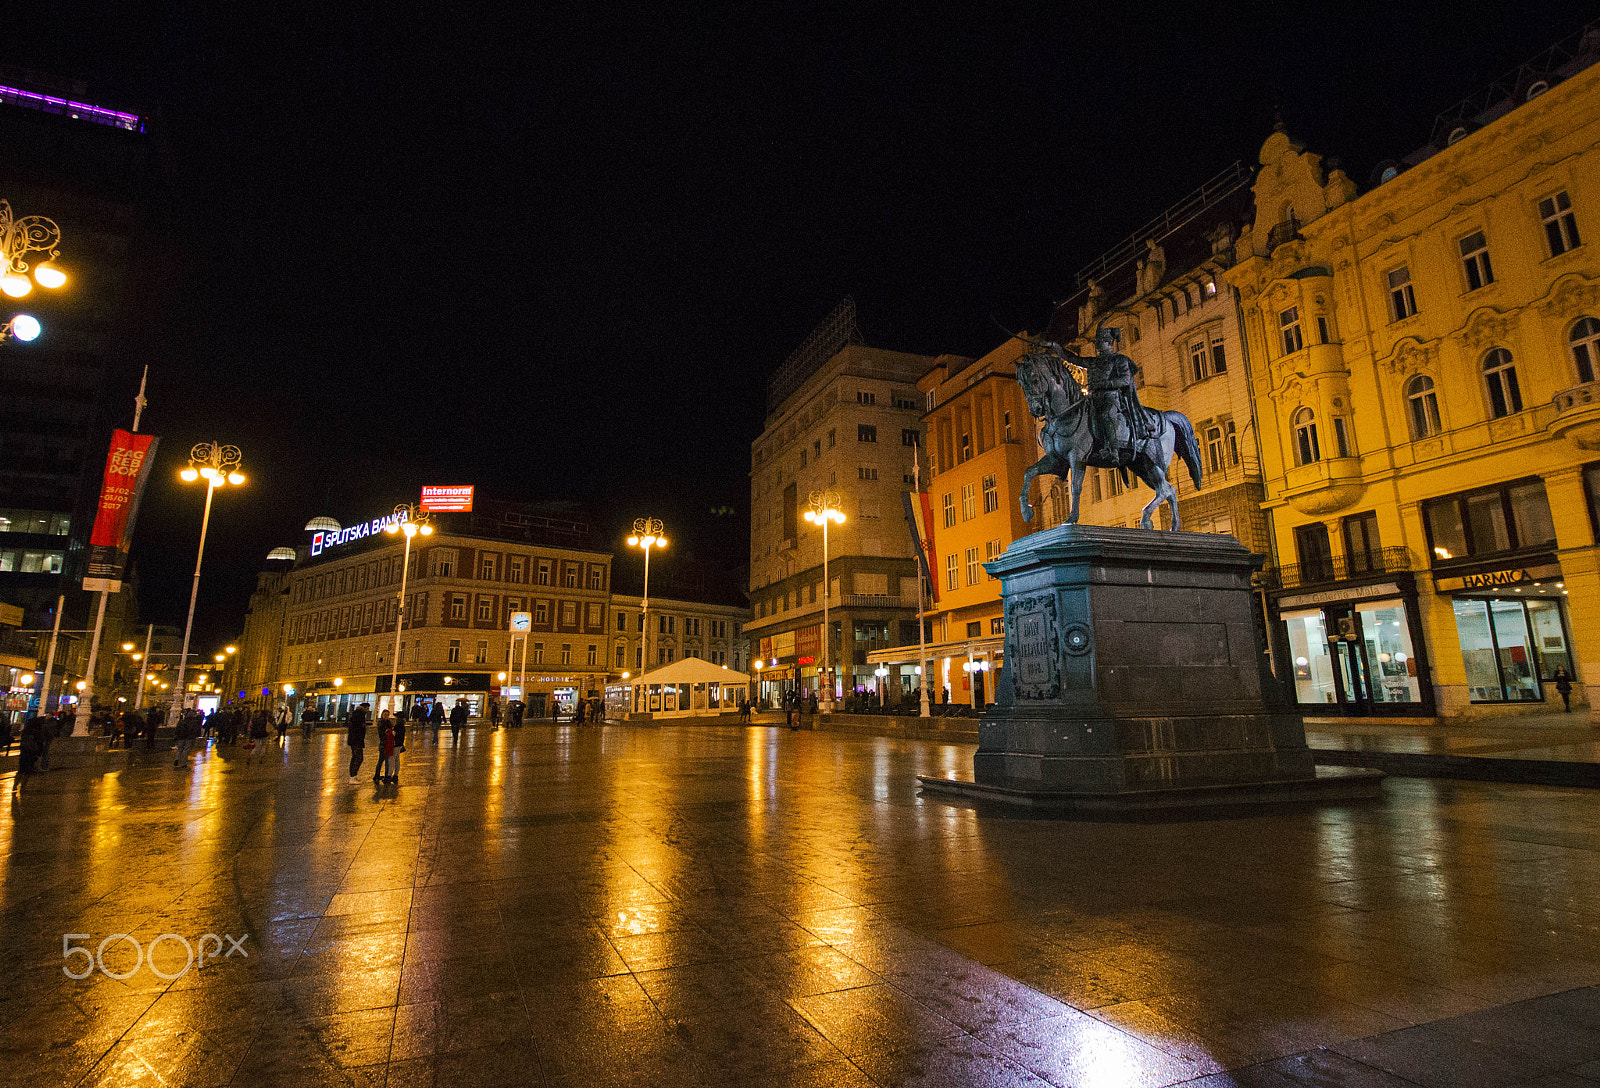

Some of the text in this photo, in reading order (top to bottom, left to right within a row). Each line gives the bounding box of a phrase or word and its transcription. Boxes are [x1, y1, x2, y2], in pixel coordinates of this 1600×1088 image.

[113, 447, 144, 460] ZAG
[111, 455, 141, 468] REB
[109, 464, 138, 478] DOX
[423, 486, 472, 496] Internorm
[102, 502, 122, 510] 2017
[324, 522, 370, 548] SPLITSKA
[1462, 568, 1533, 588] HARMICA
[1312, 586, 1380, 602] Galerija Mala
